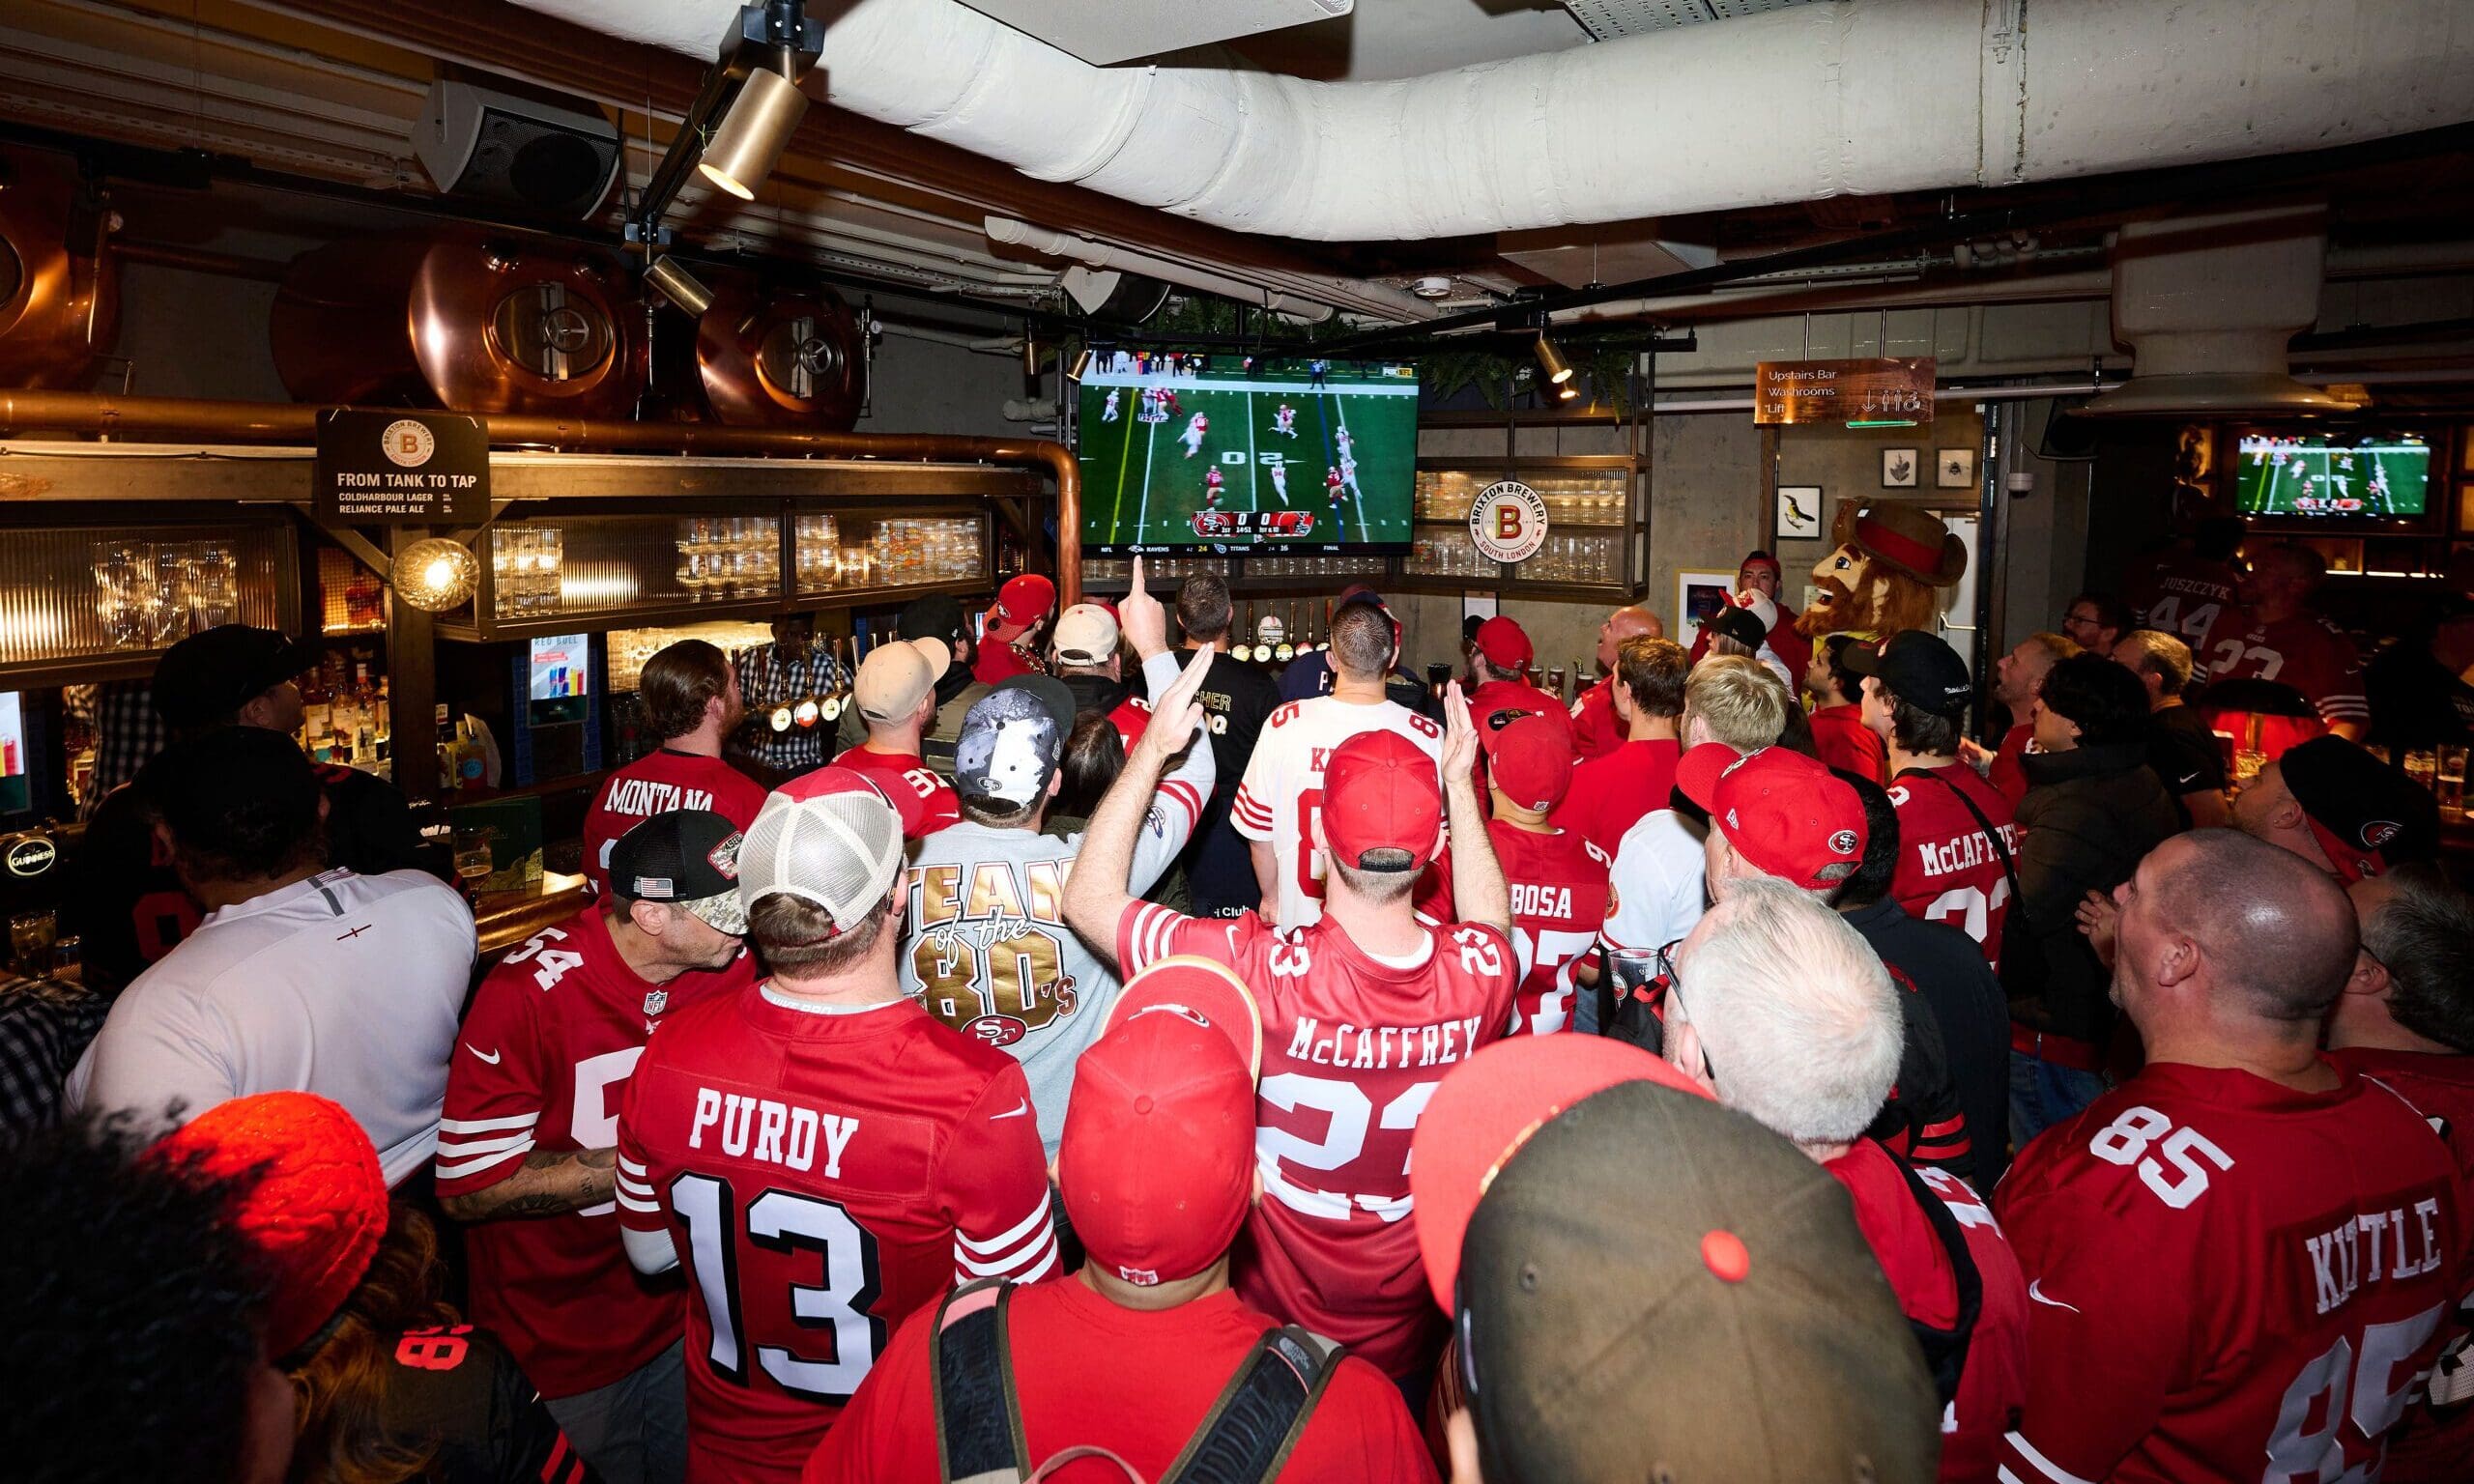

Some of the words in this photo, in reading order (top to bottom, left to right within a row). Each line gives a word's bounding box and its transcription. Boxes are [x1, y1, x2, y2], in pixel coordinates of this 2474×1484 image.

[1769, 371, 1815, 382] Upstairs
[1818, 370, 1836, 380] Bar
[1769, 386, 1835, 397] Washrooms
[1767, 404, 1785, 414] Lift
[400, 434, 418, 454] B
[337, 472, 380, 487] FROM
[386, 473, 424, 488] TANK
[428, 474, 446, 488] TO
[450, 475, 477, 488] TAP
[339, 492, 403, 501] COLDHARBOUR
[406, 493, 433, 502] LAGER
[339, 504, 383, 514] RELIANCE
[385, 504, 407, 514] PALE
[409, 504, 424, 514] ALE
[1472, 484, 1505, 526] BRIXTON
[1507, 484, 1545, 526] BREWERY
[1238, 513, 1248, 526] 0
[1260, 513, 1271, 526] 0
[1495, 505, 1523, 539] B
[1480, 541, 1504, 558] SOUTH
[1507, 541, 1536, 560] LONDON
[2148, 595, 2222, 651] 44
[604, 777, 713, 816] MONTANA
[12, 850, 54, 867] GUINNESS
[1510, 883, 1572, 919] BOSA
[934, 908, 965, 969] of
[974, 903, 1033, 952] the
[1286, 1015, 1482, 1070] McCAFFREY
[688, 1087, 859, 1179] PURDY
[2089, 1105, 2235, 1209] 85
[669, 1169, 889, 1406] 13
